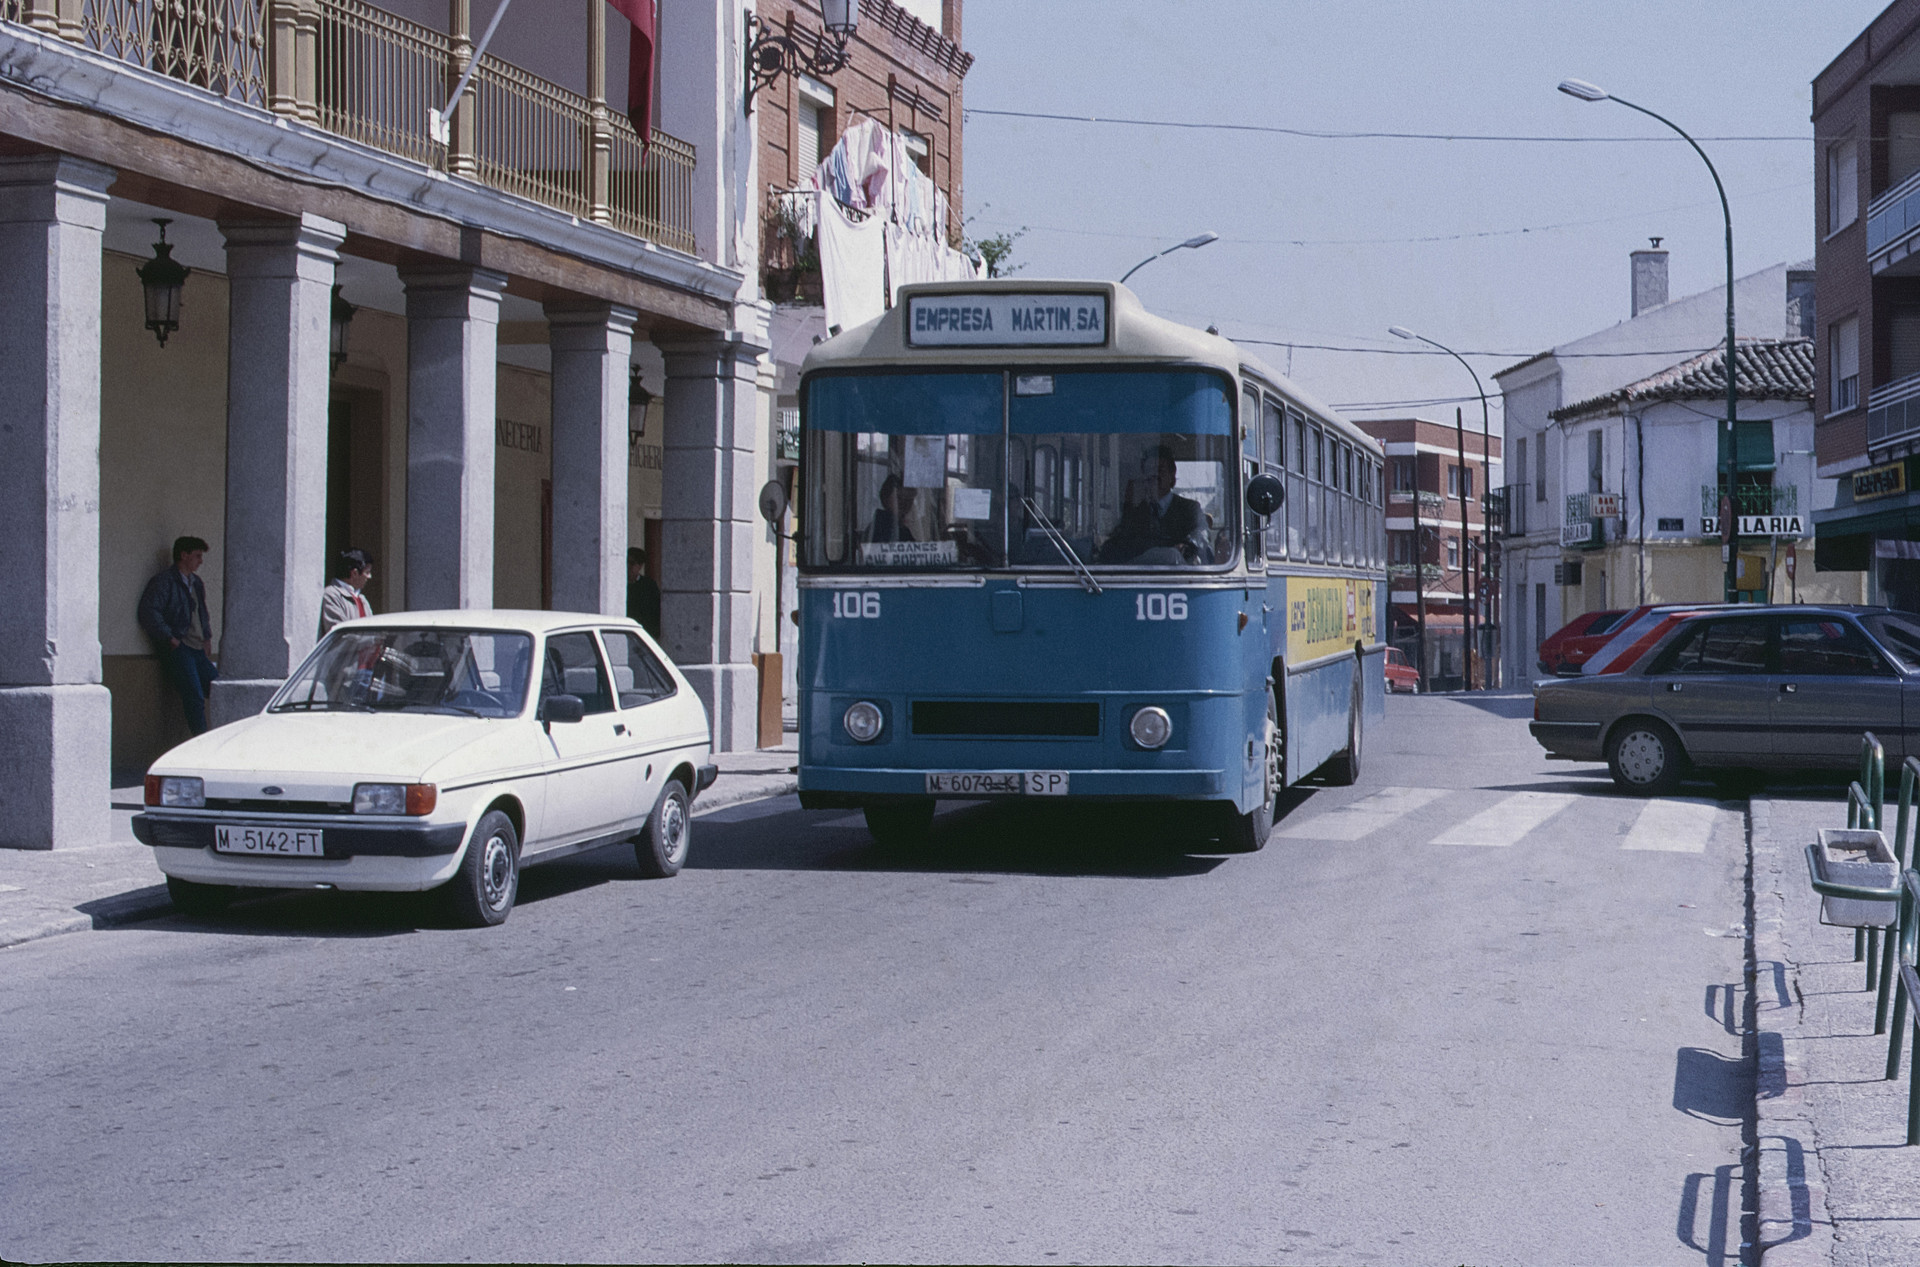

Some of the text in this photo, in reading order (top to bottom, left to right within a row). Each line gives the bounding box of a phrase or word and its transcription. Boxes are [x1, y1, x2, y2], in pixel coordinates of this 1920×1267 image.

[915, 307, 993, 331] EMPRESA
[1743, 517, 1766, 533] LA
[1770, 517, 1802, 533] RIA
[833, 591, 881, 618] 106
[1136, 593, 1188, 620] 106
